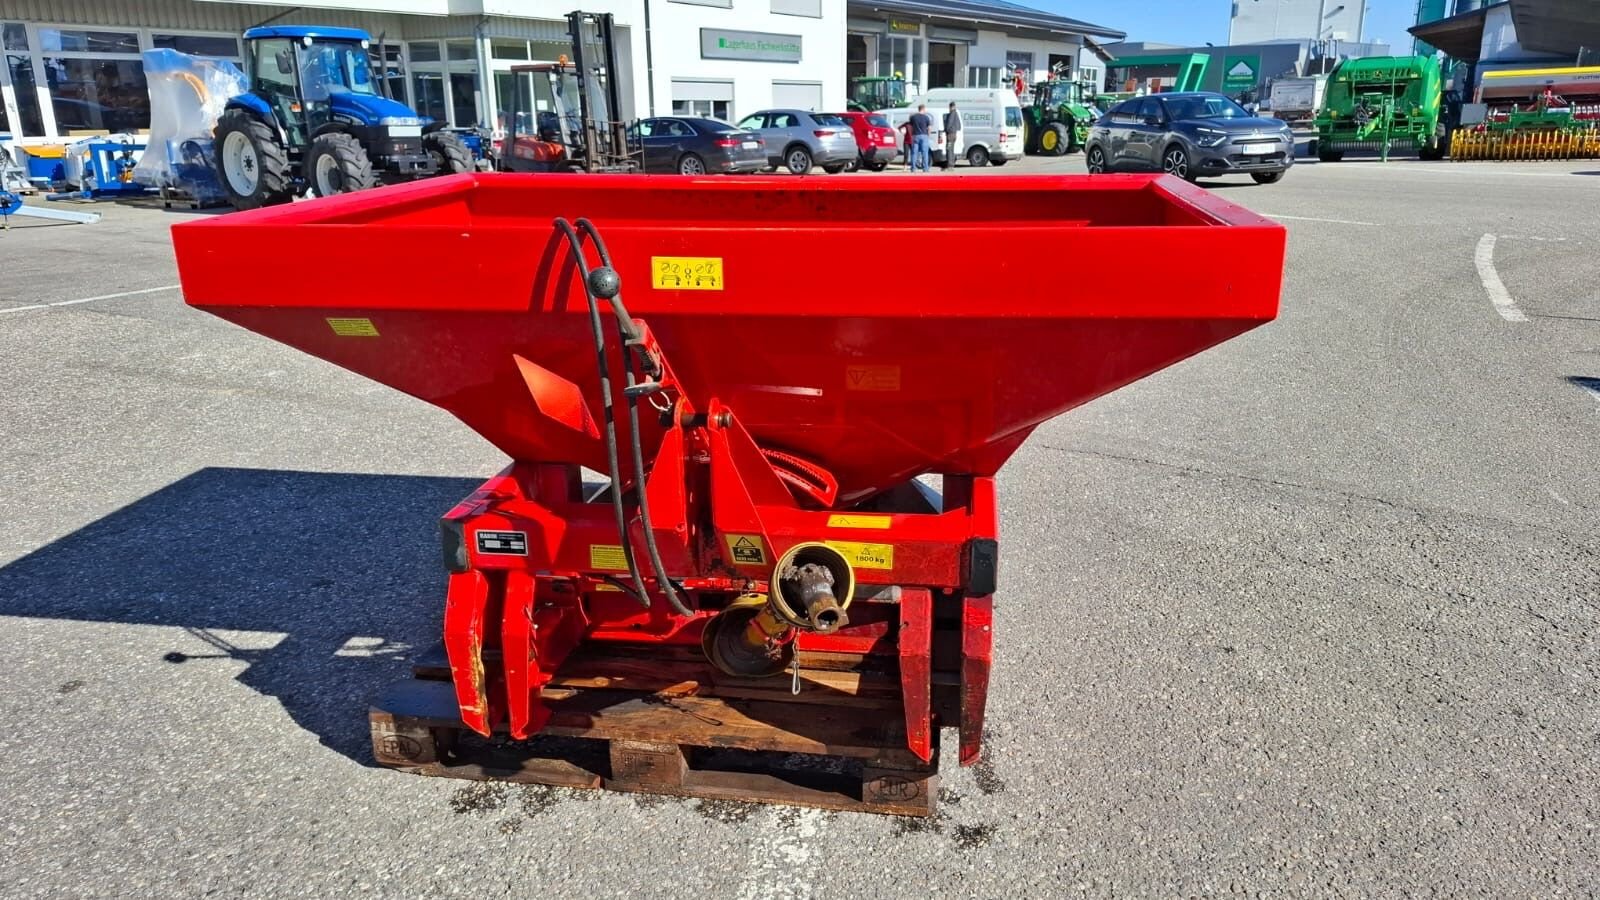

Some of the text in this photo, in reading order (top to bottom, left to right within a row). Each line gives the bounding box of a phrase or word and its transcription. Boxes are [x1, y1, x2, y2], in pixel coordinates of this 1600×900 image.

[725, 39, 755, 51] Lagerhaus
[963, 112, 991, 121] DEERE
[875, 556, 885, 564] kg
[383, 740, 412, 754] EPAL
